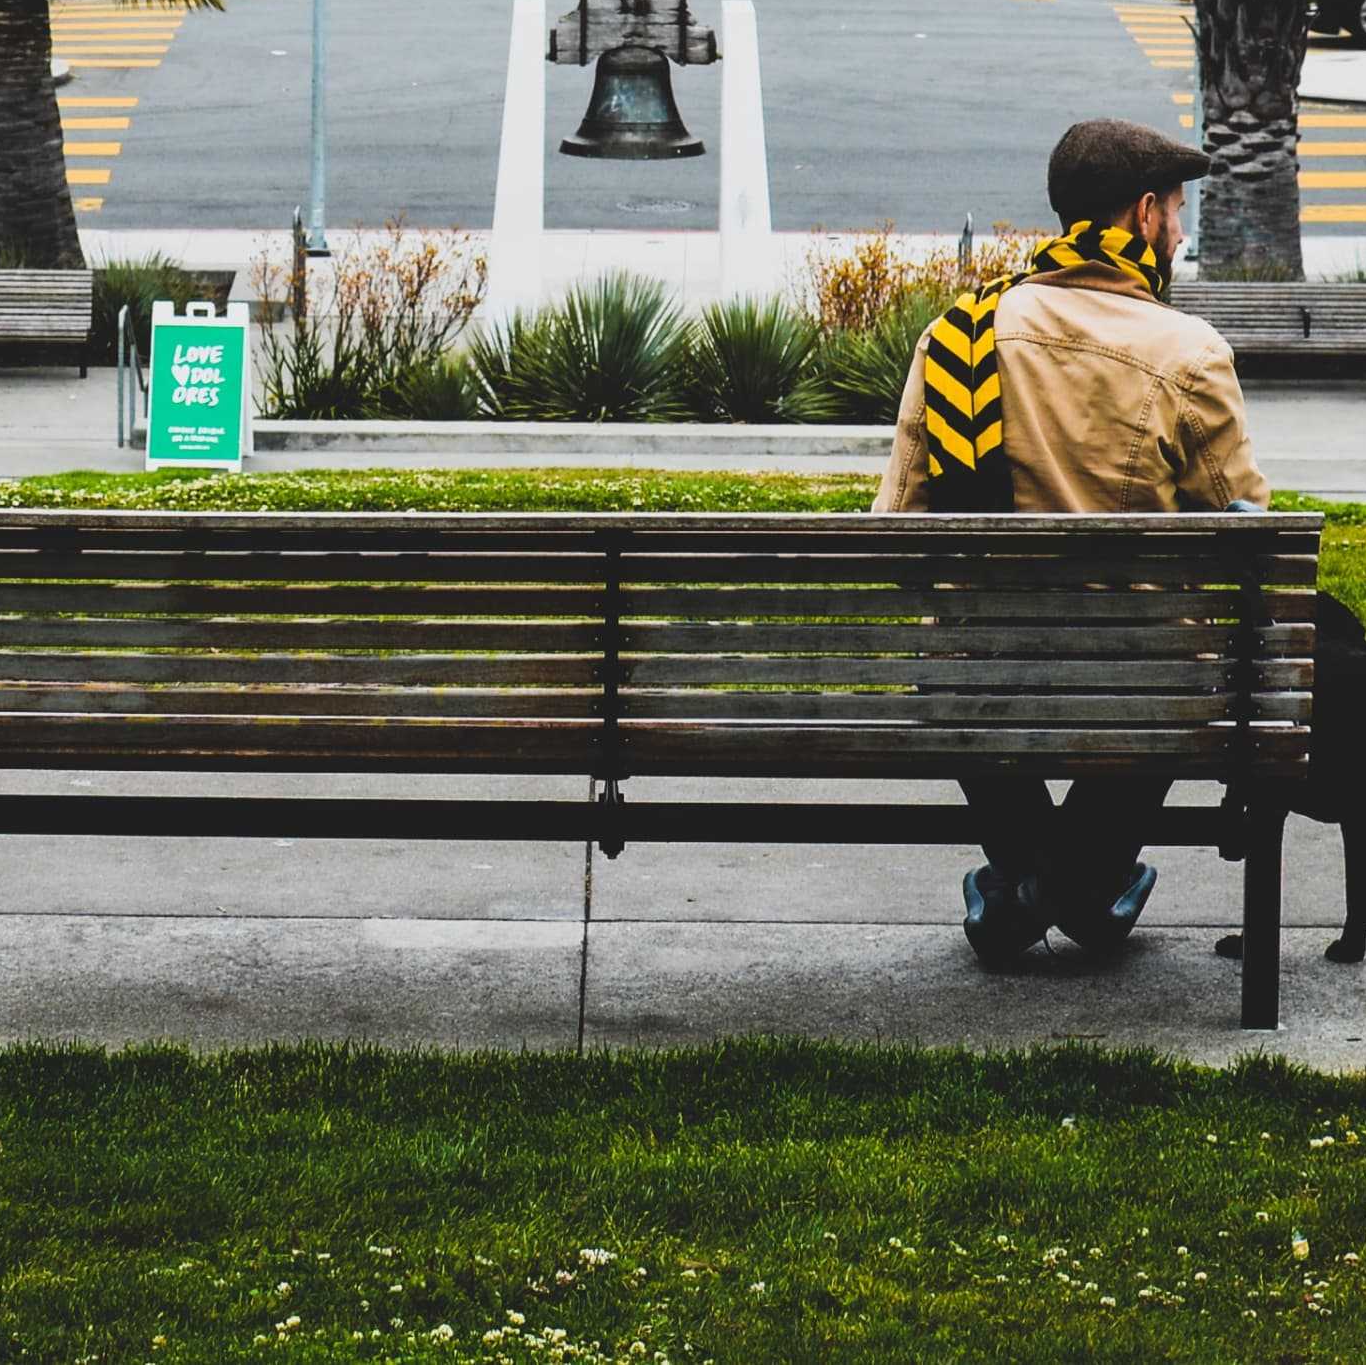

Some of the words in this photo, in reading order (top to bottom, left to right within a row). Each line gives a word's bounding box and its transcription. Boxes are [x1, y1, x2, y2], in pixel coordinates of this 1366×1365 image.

[174, 344, 224, 364] LOVE
[190, 367, 226, 384] DOL
[172, 386, 220, 406] ORES
